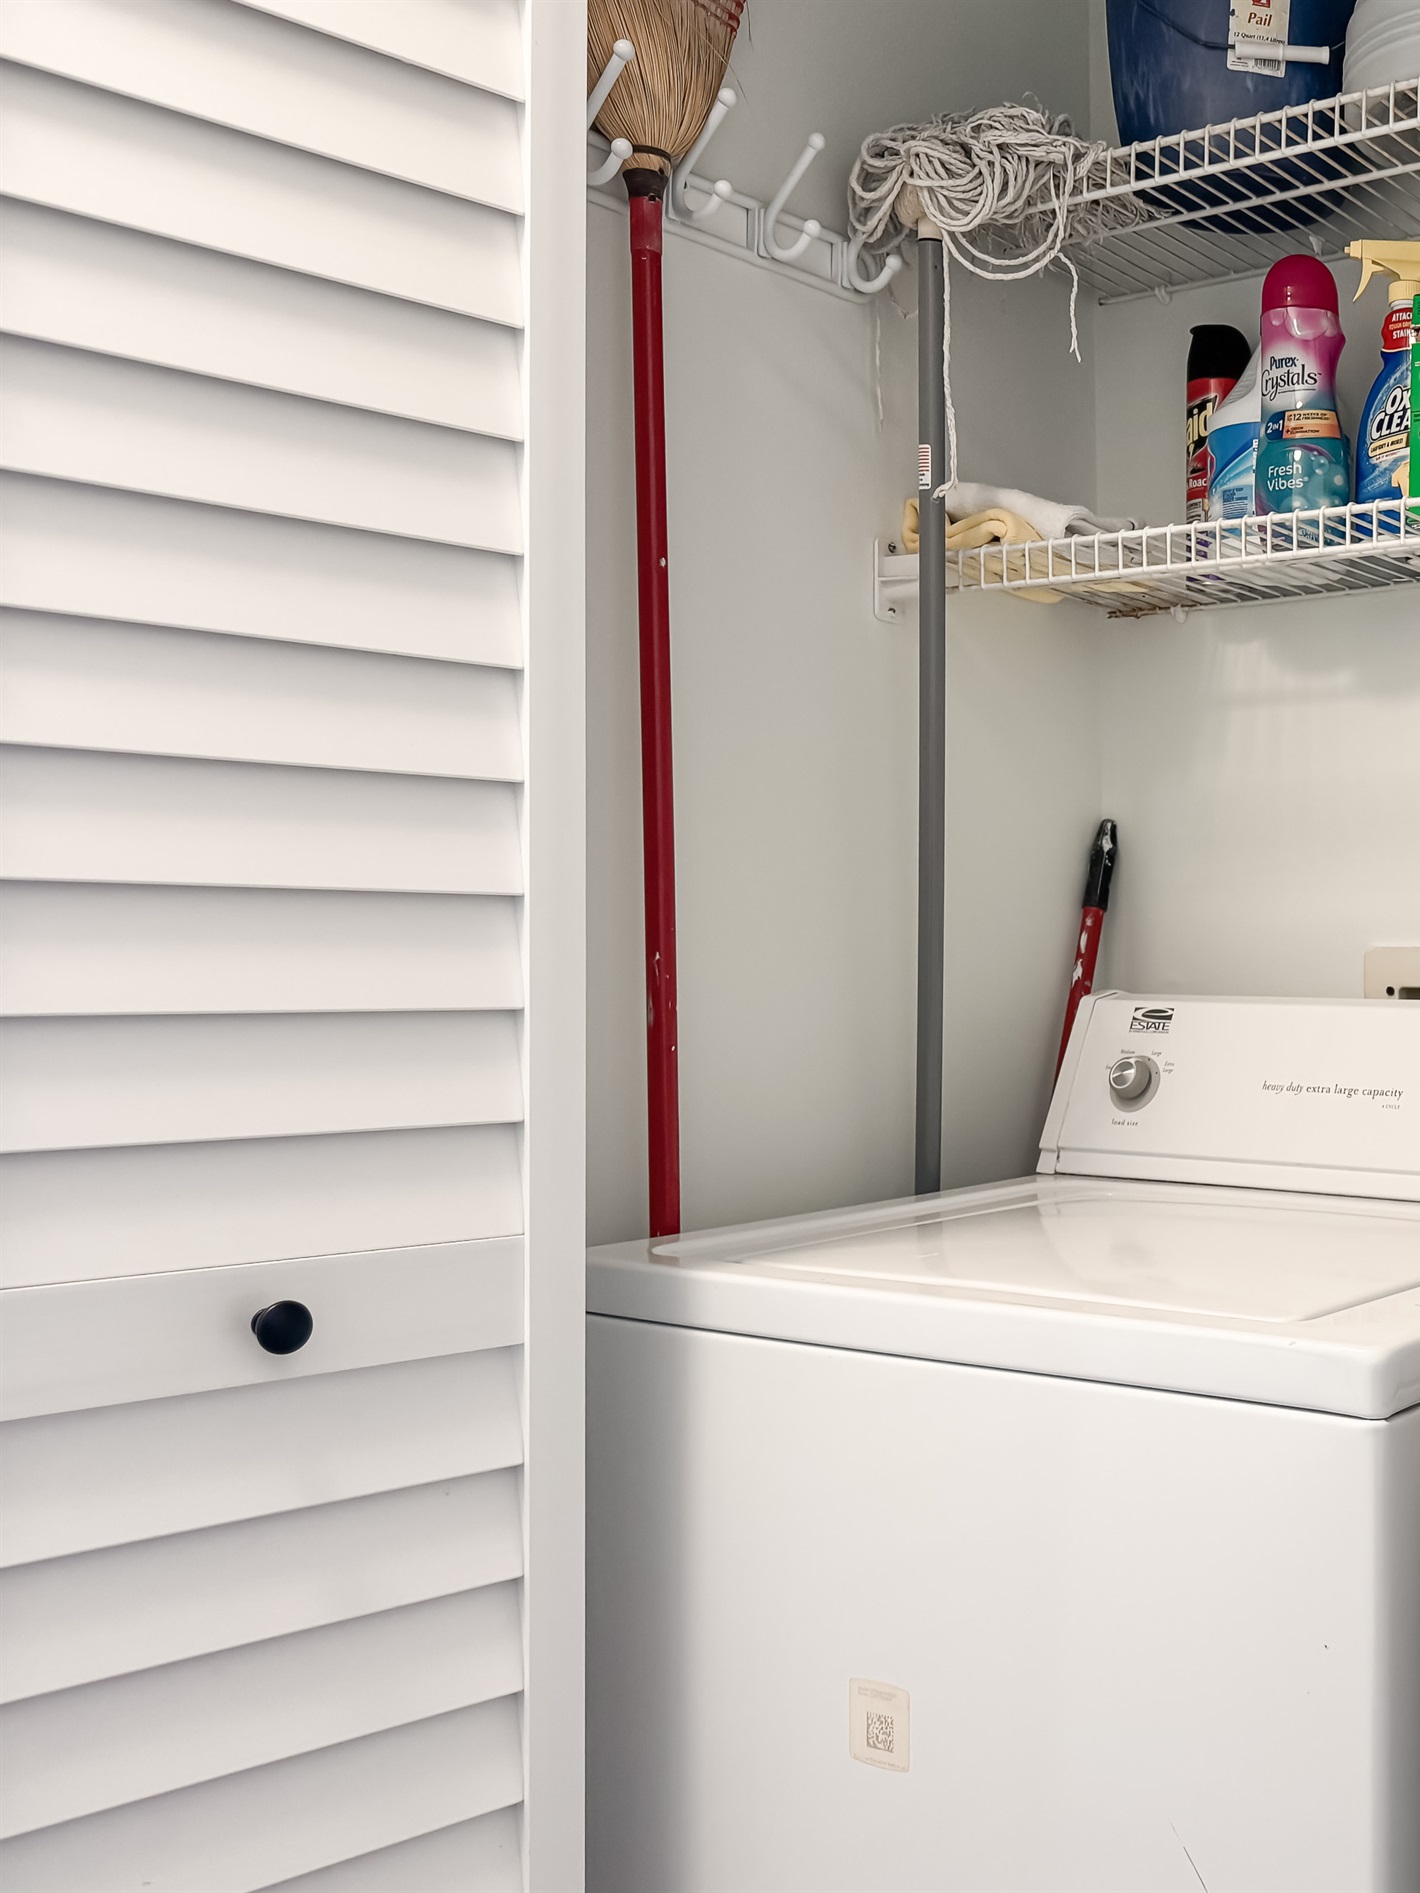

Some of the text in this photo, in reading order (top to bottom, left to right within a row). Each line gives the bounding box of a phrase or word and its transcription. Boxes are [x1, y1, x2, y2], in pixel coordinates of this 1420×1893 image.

[1247, 12, 1272, 26] Pail
[1392, 312, 1412, 322] ATTAC
[1270, 356, 1297, 370] Purex
[1262, 364, 1318, 401] Crystals
[1187, 402, 1213, 446] aid
[1293, 413, 1302, 421] 12
[1371, 409, 1411, 440] CLEA
[1268, 462, 1302, 478] Fresh
[1189, 477, 1208, 488] Roac
[1267, 477, 1304, 492] Vibes
[1130, 1021, 1171, 1031] ESTATE
[1262, 1080, 1404, 1101] heavy duty extra large capacity
[1111, 1118, 1125, 1126] load
